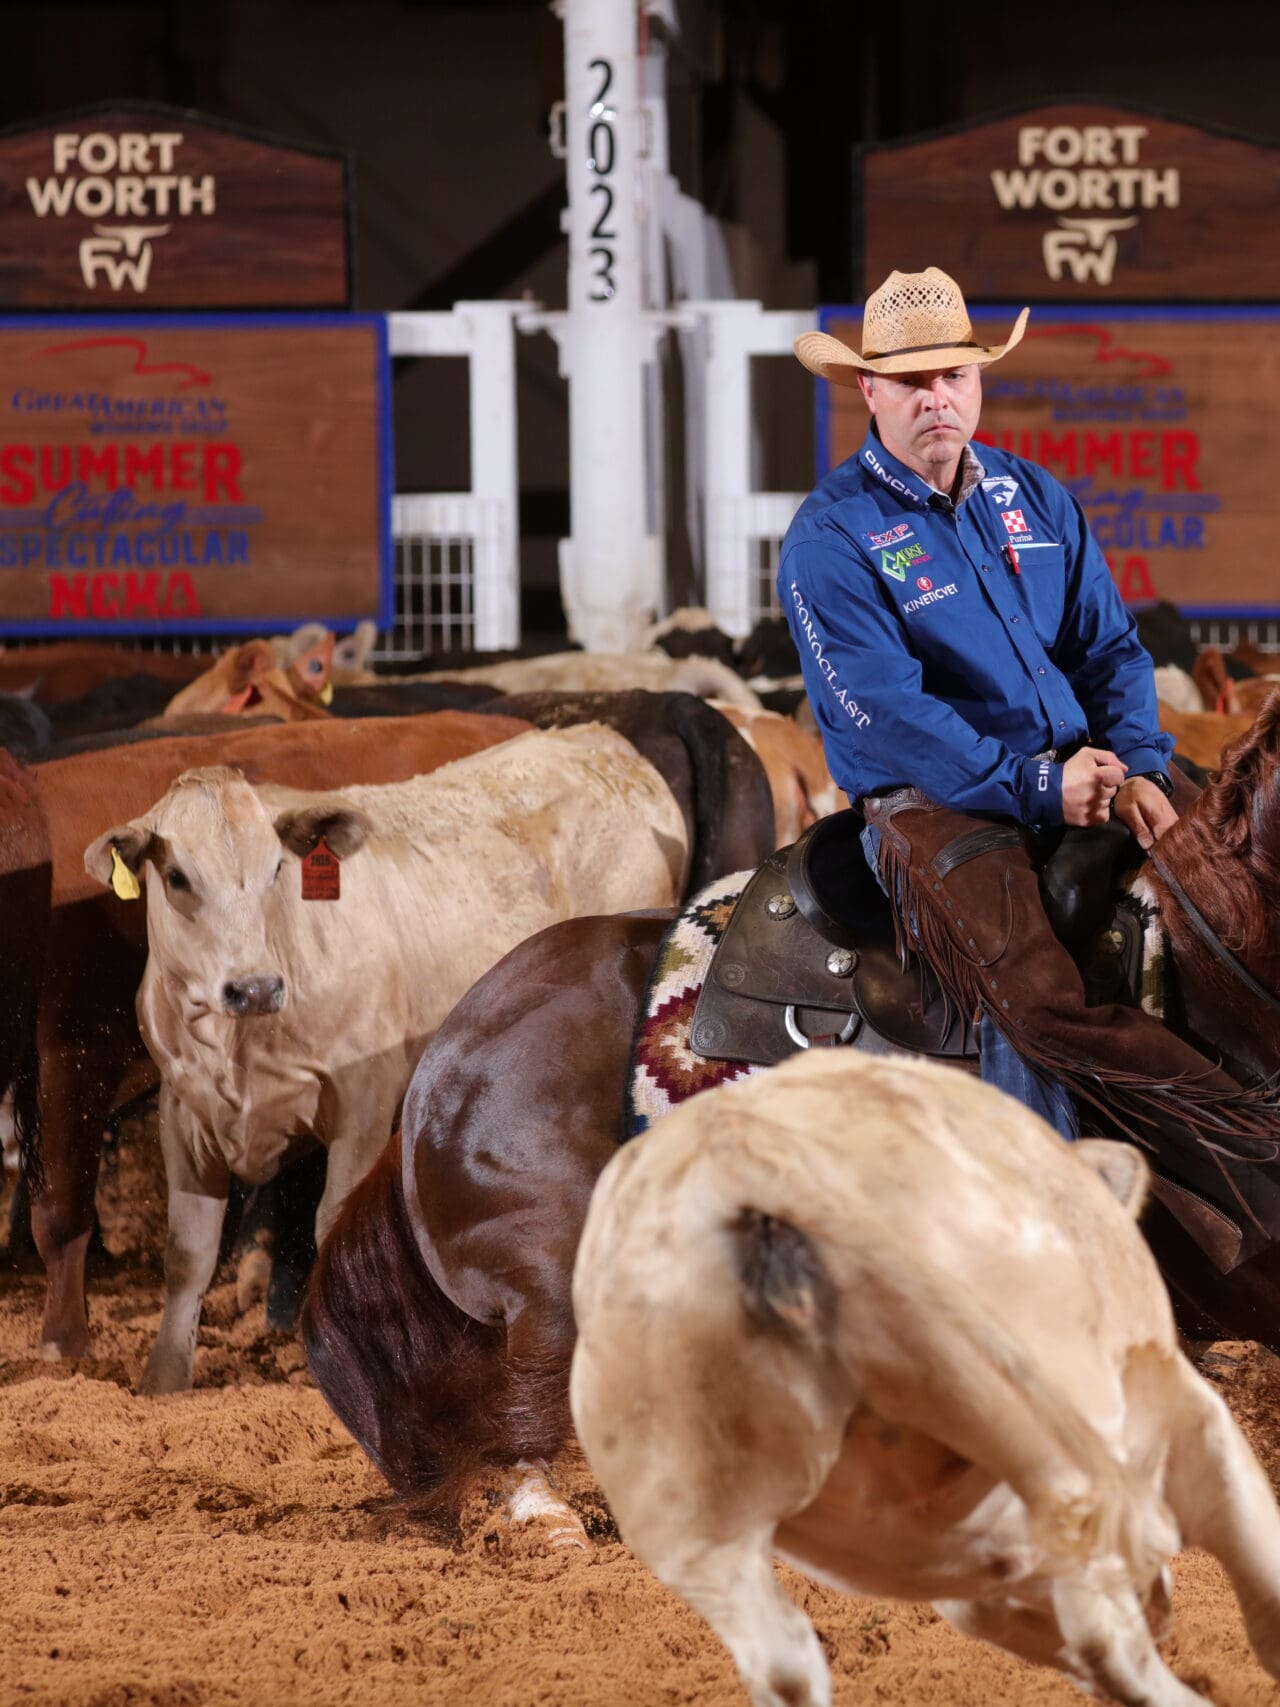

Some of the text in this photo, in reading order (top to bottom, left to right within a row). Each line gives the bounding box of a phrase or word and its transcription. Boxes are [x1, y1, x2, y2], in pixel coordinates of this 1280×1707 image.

[54, 133, 183, 173] FORT
[1018, 126, 1148, 167] FORT
[26, 176, 215, 216] WORTH
[588, 59, 617, 303] 2023
[991, 168, 1180, 209] WORTH
[0, 443, 245, 506] SUMMER
[865, 450, 920, 501] CINCH
[0, 532, 250, 568] SPECTACULAR
[1008, 534, 1033, 544] Purina
[903, 583, 959, 614] KINETICVET
[791, 580, 871, 731] ICONOCLAST
